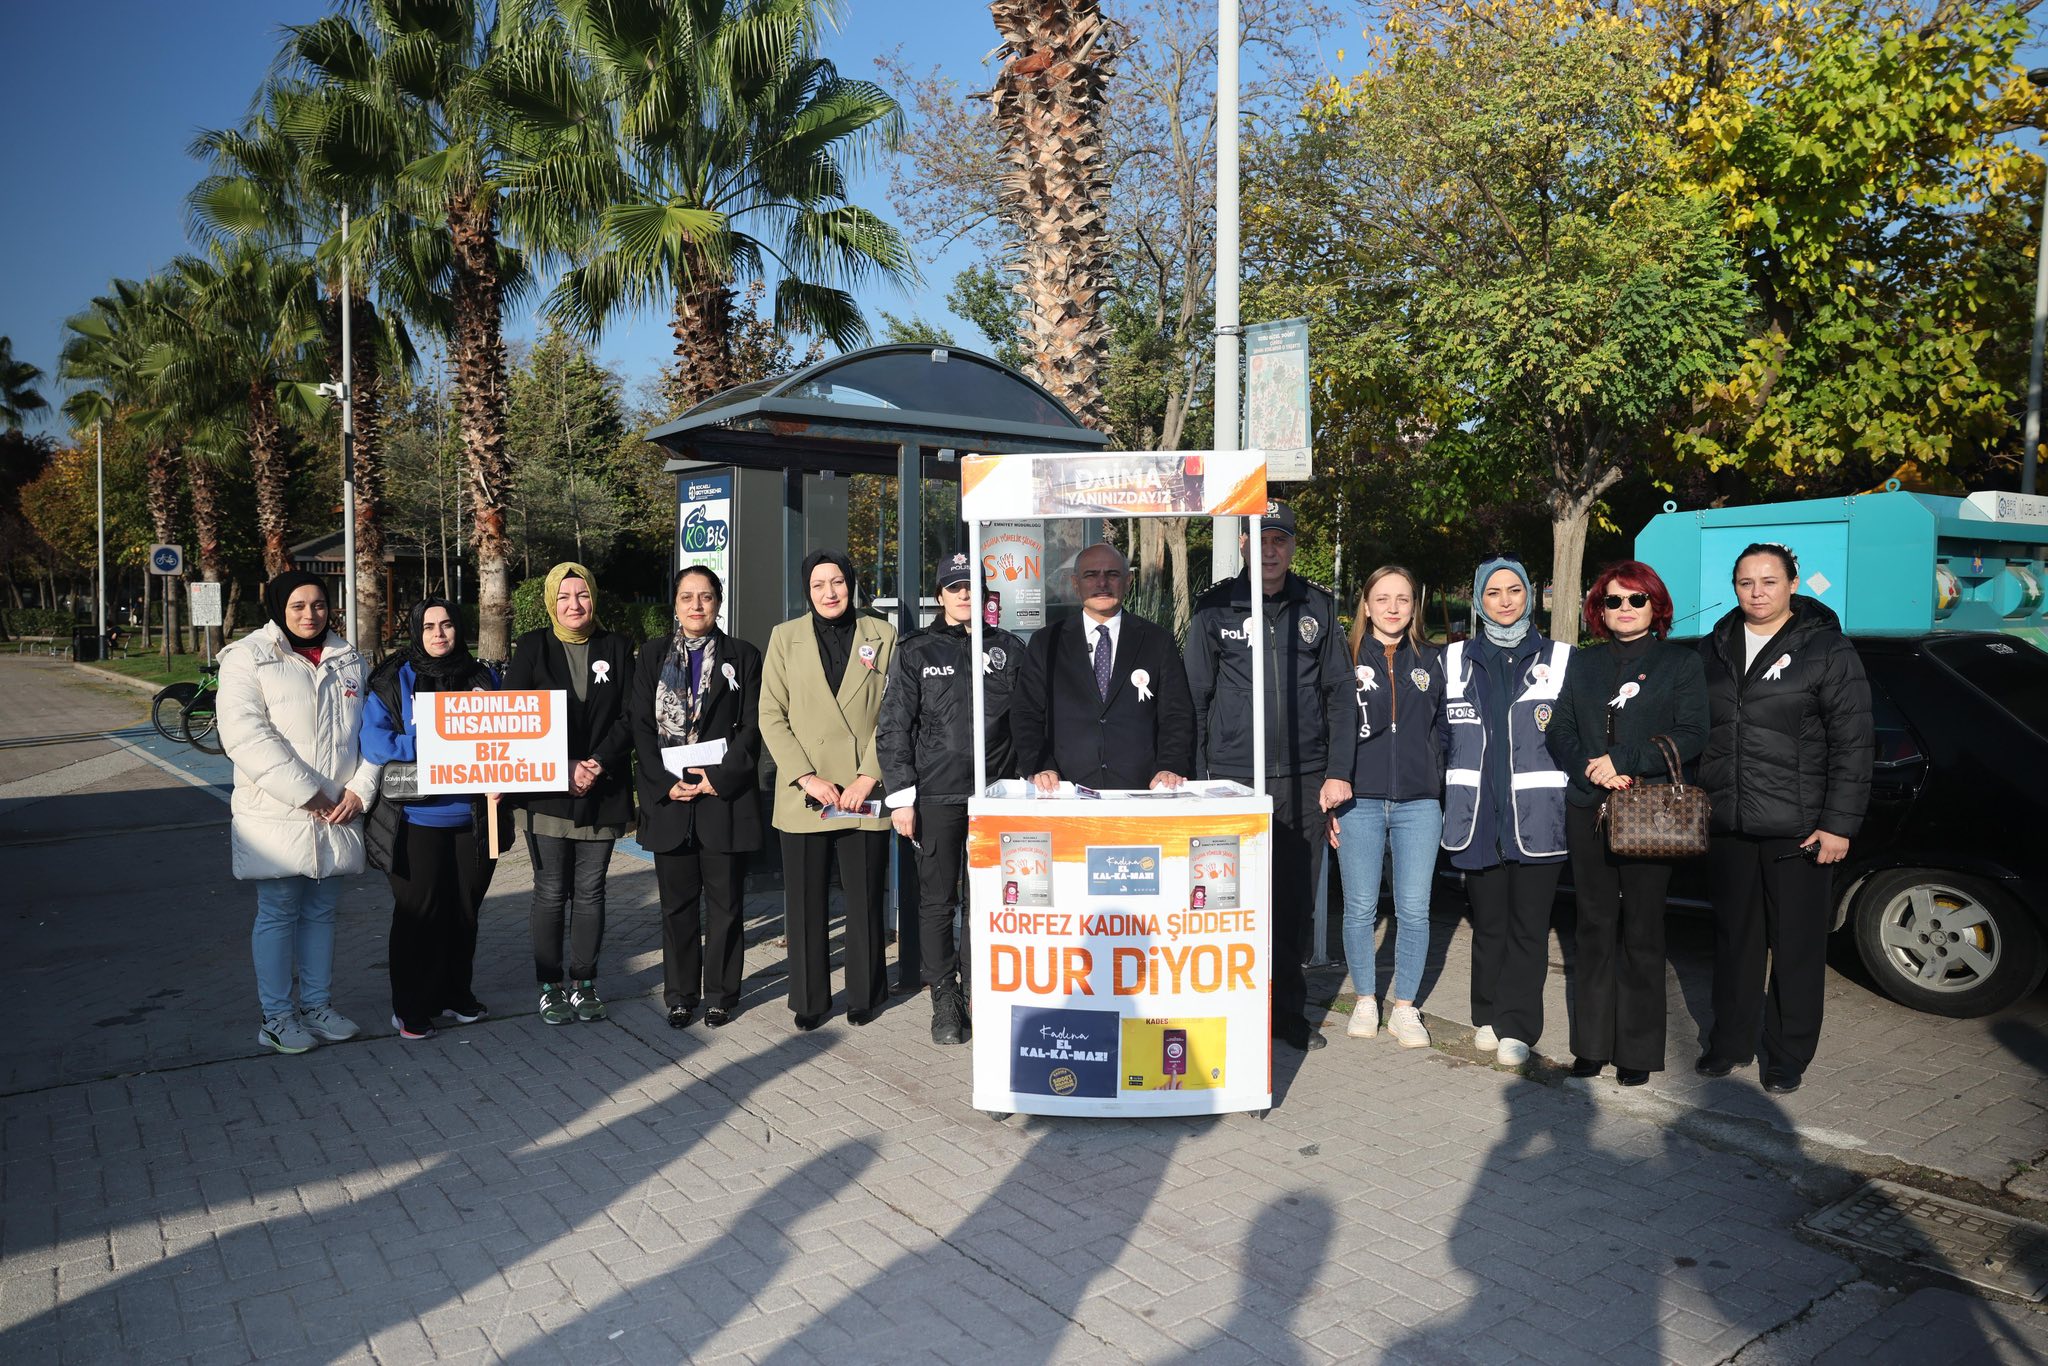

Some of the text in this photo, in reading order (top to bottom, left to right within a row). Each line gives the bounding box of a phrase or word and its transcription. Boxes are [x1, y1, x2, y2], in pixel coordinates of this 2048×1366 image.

[1067, 489, 1171, 506] YANINIZDAYIZ
[444, 695, 539, 714] KADINLAR
[989, 908, 1256, 941] KÖRFEZ KADINA ŞİDDETE
[990, 944, 1096, 996] DUR
[1056, 1039, 1072, 1050] EL
